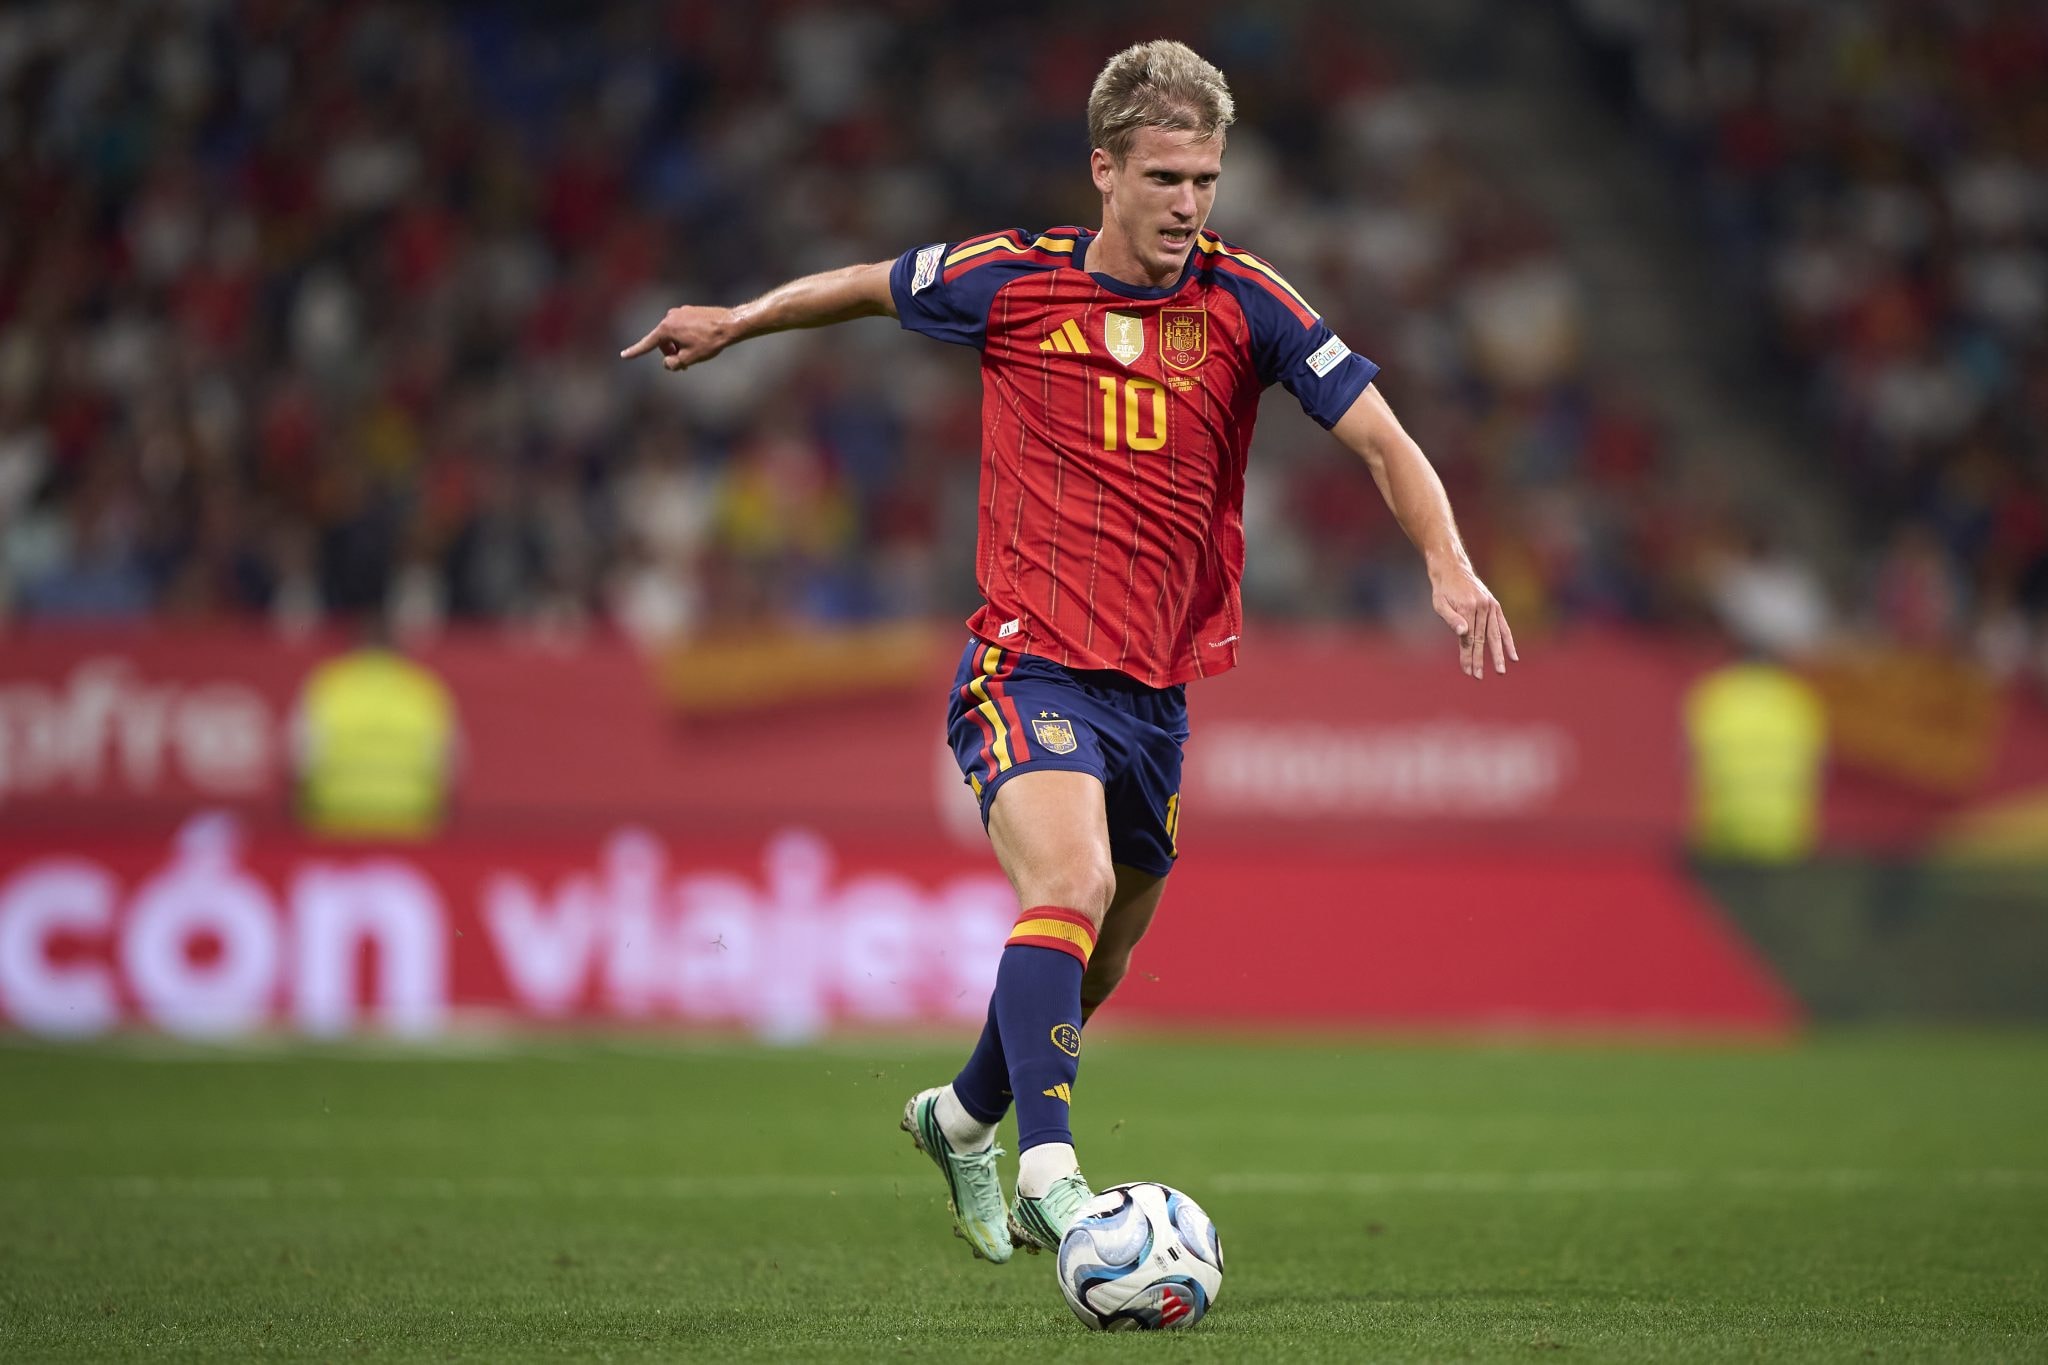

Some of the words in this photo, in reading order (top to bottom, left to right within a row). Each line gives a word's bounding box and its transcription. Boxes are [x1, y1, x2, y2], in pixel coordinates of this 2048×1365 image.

[1308, 352, 1322, 364] UEFA
[1099, 376, 1167, 451] 10
[1165, 793, 1181, 858] 1
[0, 812, 447, 1038] cón
[482, 828, 1012, 1042] viajes
